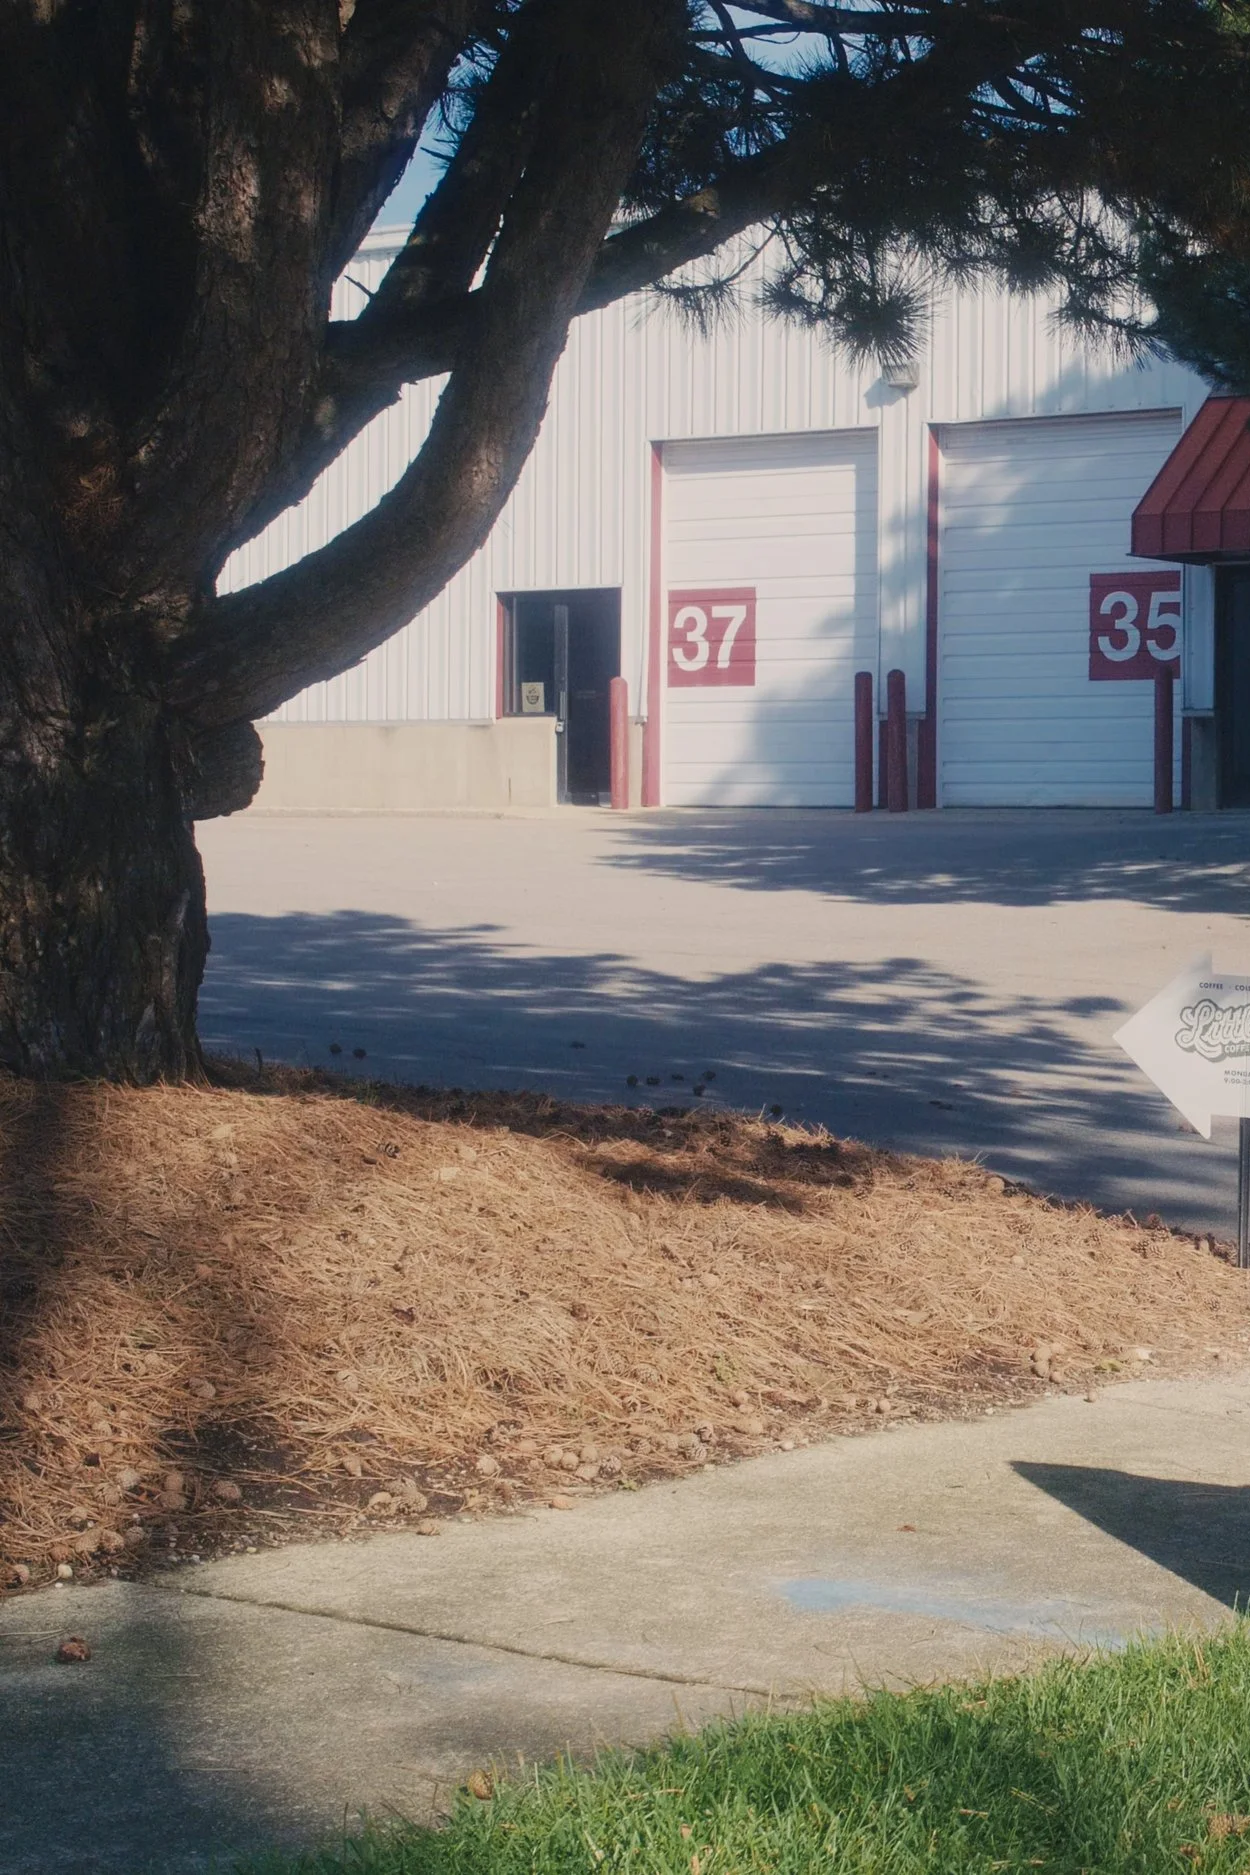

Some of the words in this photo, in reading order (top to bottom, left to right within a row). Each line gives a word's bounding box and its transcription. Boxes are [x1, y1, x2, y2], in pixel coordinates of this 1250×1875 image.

[671, 605, 747, 672] 37
[1098, 591, 1181, 662] 35
[1198, 982, 1224, 990] COFFEE
